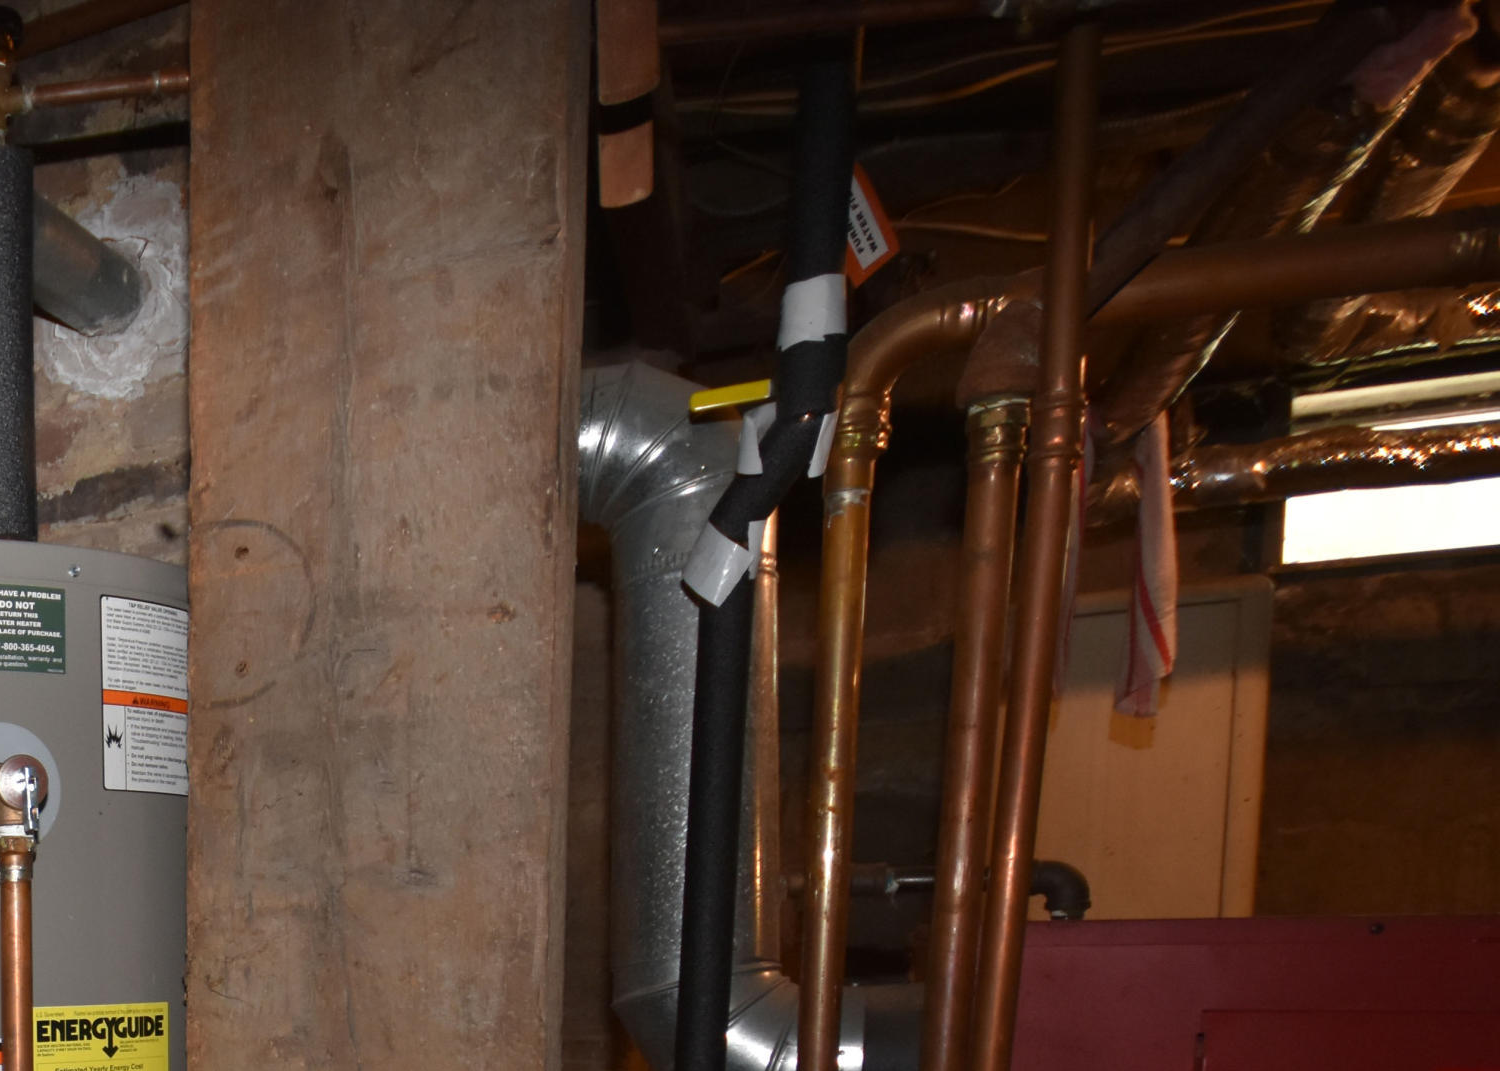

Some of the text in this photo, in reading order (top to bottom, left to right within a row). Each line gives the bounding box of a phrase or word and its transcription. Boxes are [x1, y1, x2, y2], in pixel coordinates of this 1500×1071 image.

[27, 591, 61, 600] PROBLEM
[0, 600, 35, 610] DO NOT
[16, 620, 41, 628] HEATER
[37, 1015, 164, 1042] ENERGYGUIDE
